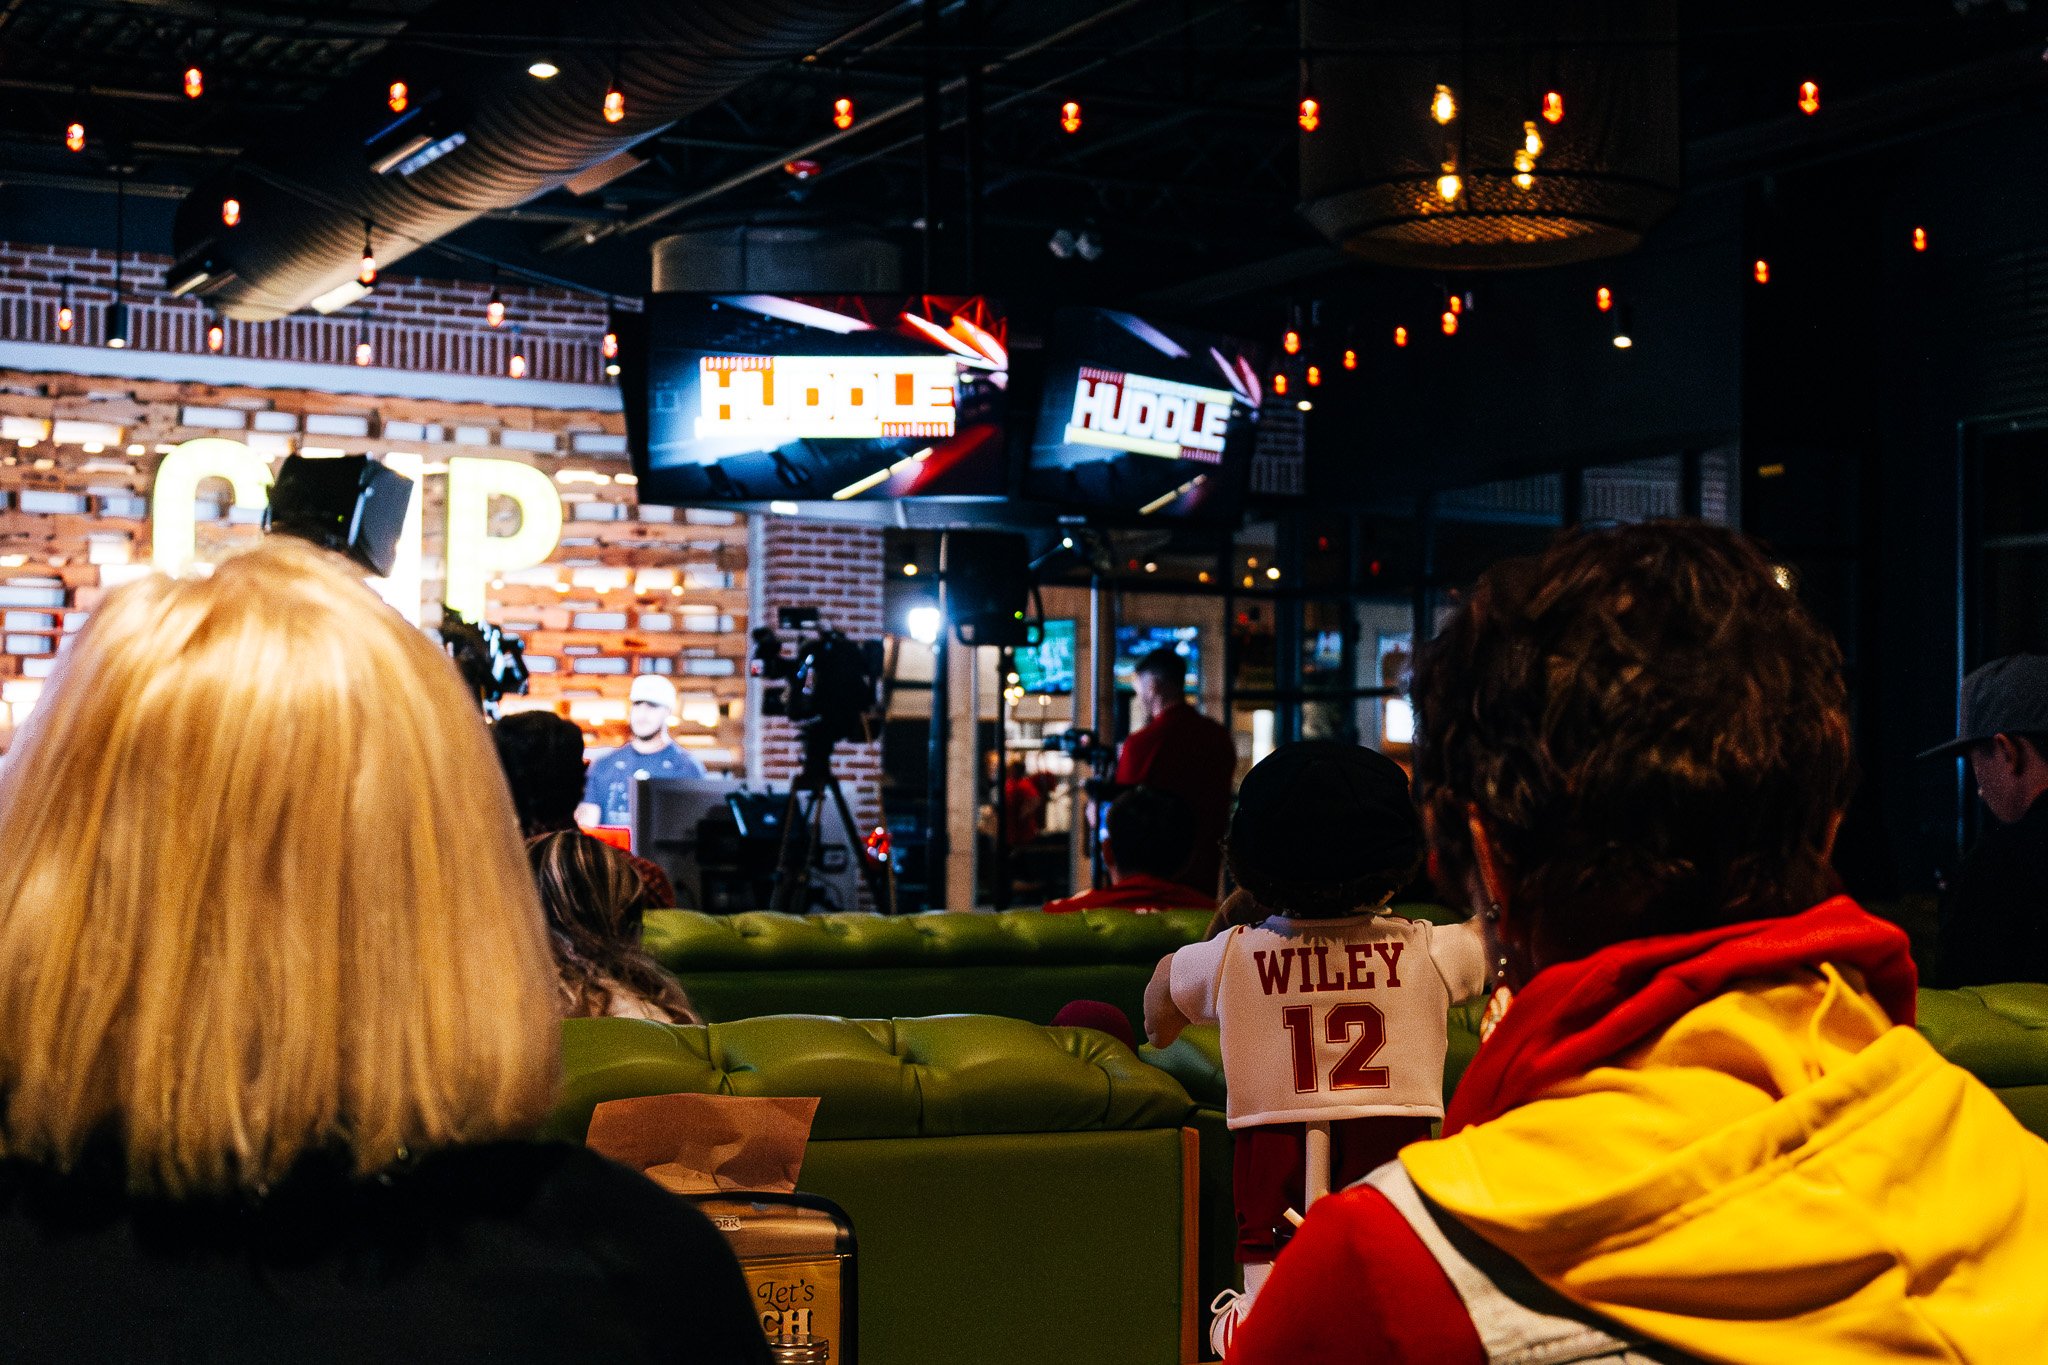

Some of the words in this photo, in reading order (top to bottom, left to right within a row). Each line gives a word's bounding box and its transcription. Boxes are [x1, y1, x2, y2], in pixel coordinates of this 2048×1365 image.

[701, 370, 956, 422] HUDDLE
[1071, 379, 1231, 452] HUDDLE
[1253, 942, 1404, 995] WILEY
[1282, 1002, 1390, 1094] 12
[715, 1219, 739, 1229] ORK
[757, 1279, 815, 1312] Let's
[760, 1308, 813, 1345] CH
